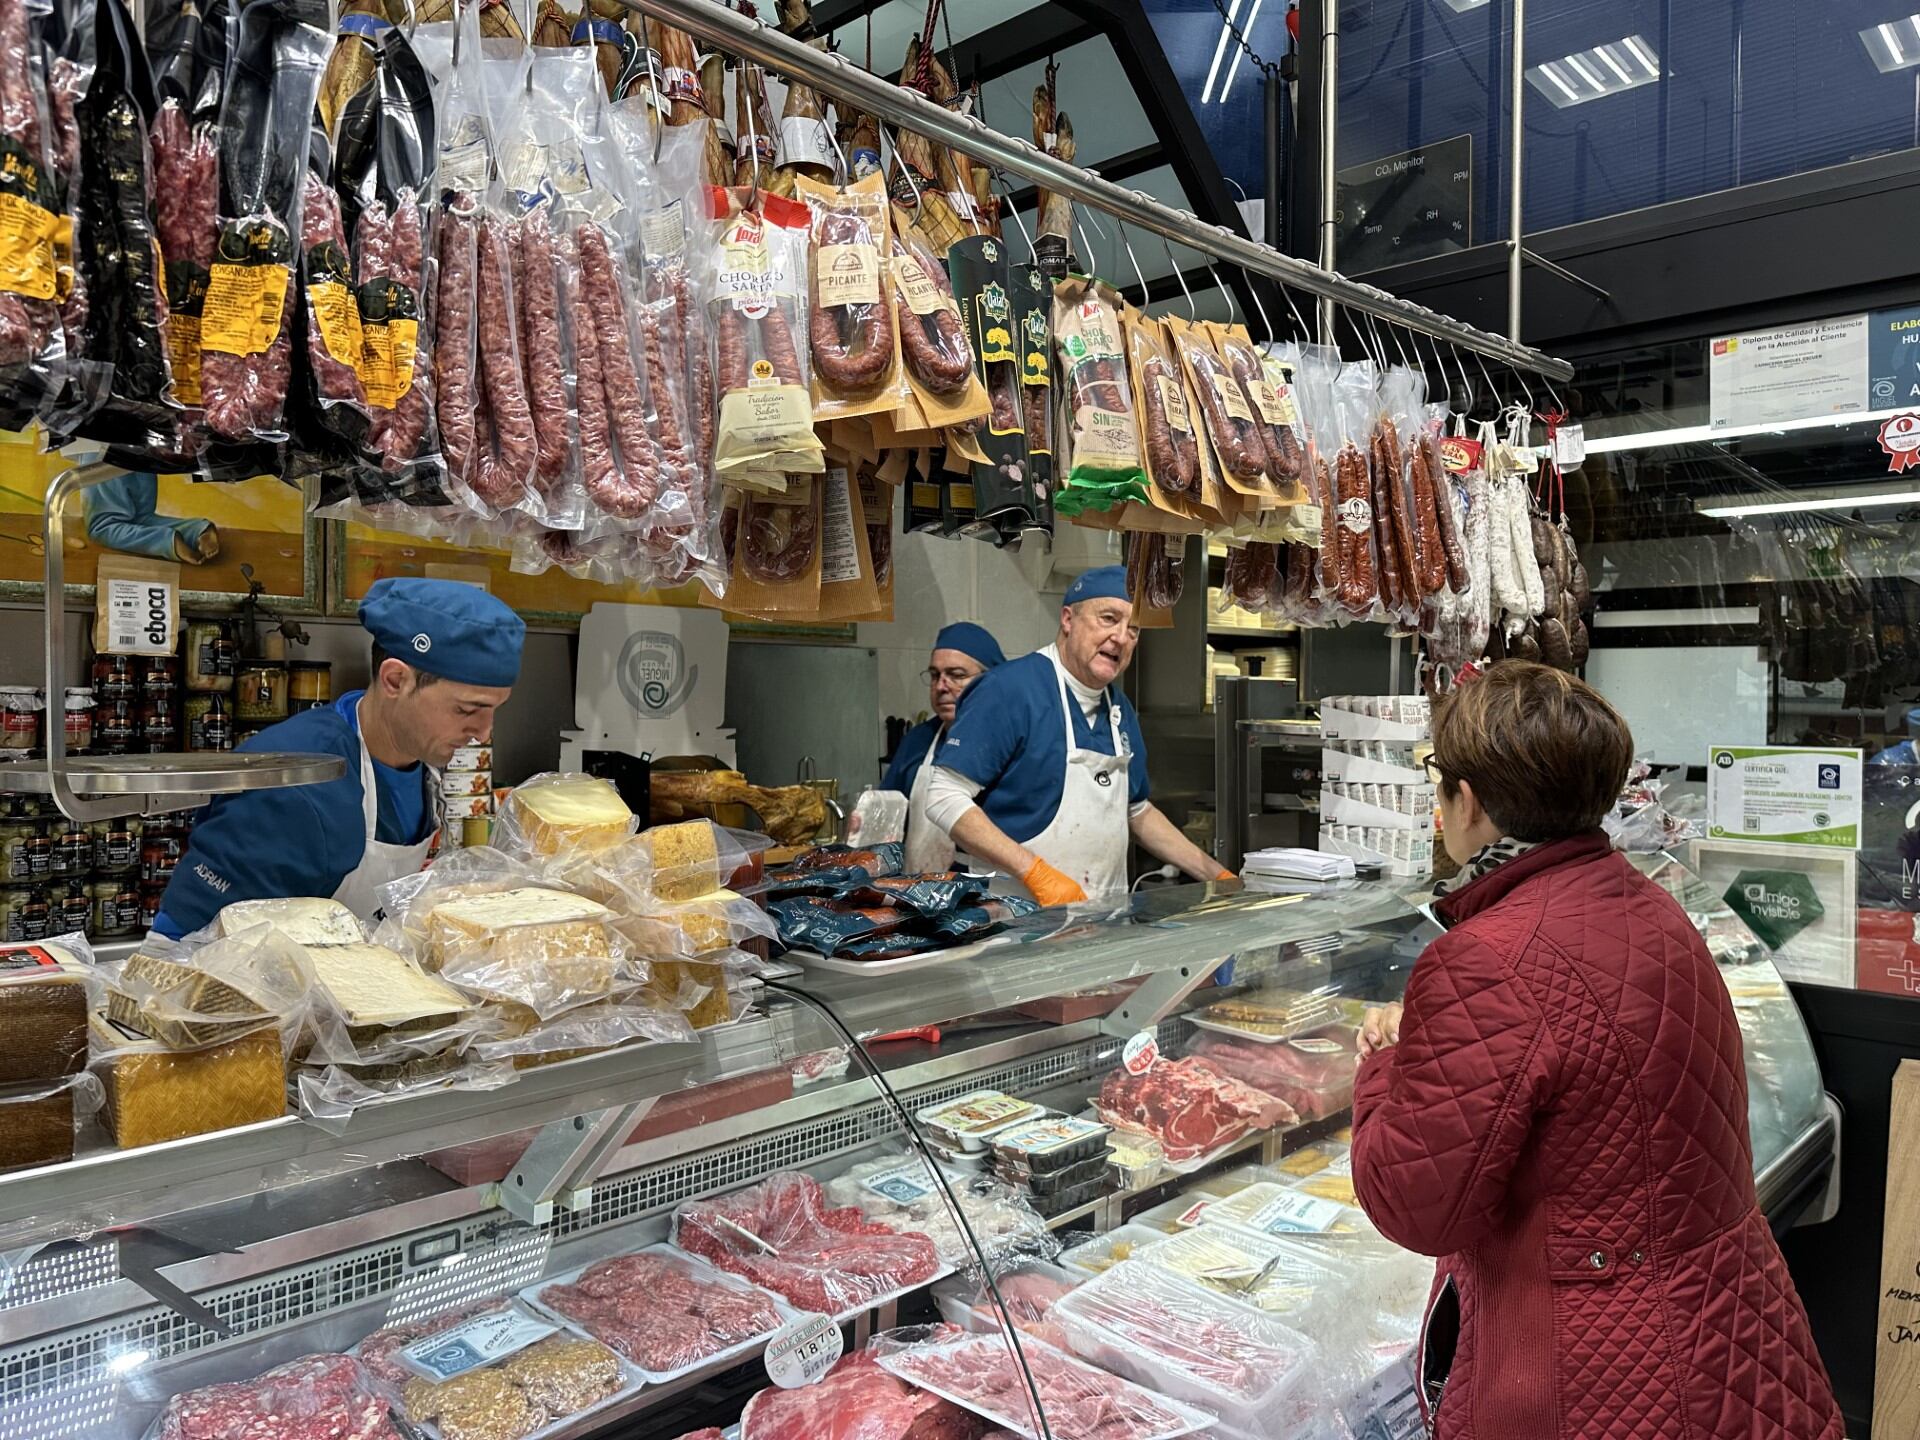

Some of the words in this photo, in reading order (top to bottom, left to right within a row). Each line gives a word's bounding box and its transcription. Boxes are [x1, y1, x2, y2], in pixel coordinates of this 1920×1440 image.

[1393, 155, 1425, 172] Monitor
[1453, 170, 1468, 182] PPM
[1426, 209, 1438, 220] RH
[1364, 224, 1382, 234] Temp
[1452, 221, 1461, 231] %
[828, 274, 867, 286] PICANTE
[906, 283, 936, 296] PICANTE
[1742, 334, 1772, 345] Diploma
[1785, 327, 1813, 338] Calidad
[1815, 327, 1820, 335] y
[1821, 320, 1863, 332] Excelencia
[1902, 334, 1920, 344] HU
[1757, 343, 1766, 351] en
[1768, 341, 1775, 349] la
[1776, 337, 1810, 348] Atención
[1820, 331, 1847, 342] Cliente
[1872, 396, 1896, 404] MIGUEL
[1093, 412, 1111, 426] SIN
[144, 587, 167, 645] eboca
[640, 668, 670, 681] MIGUEL
[261, 688, 269, 699] S
[1744, 765, 1773, 774] CERTIFICA
[194, 862, 231, 893] ADRIAN
[1750, 902, 1801, 919] invisible
[803, 1351, 838, 1378] BISTEC
